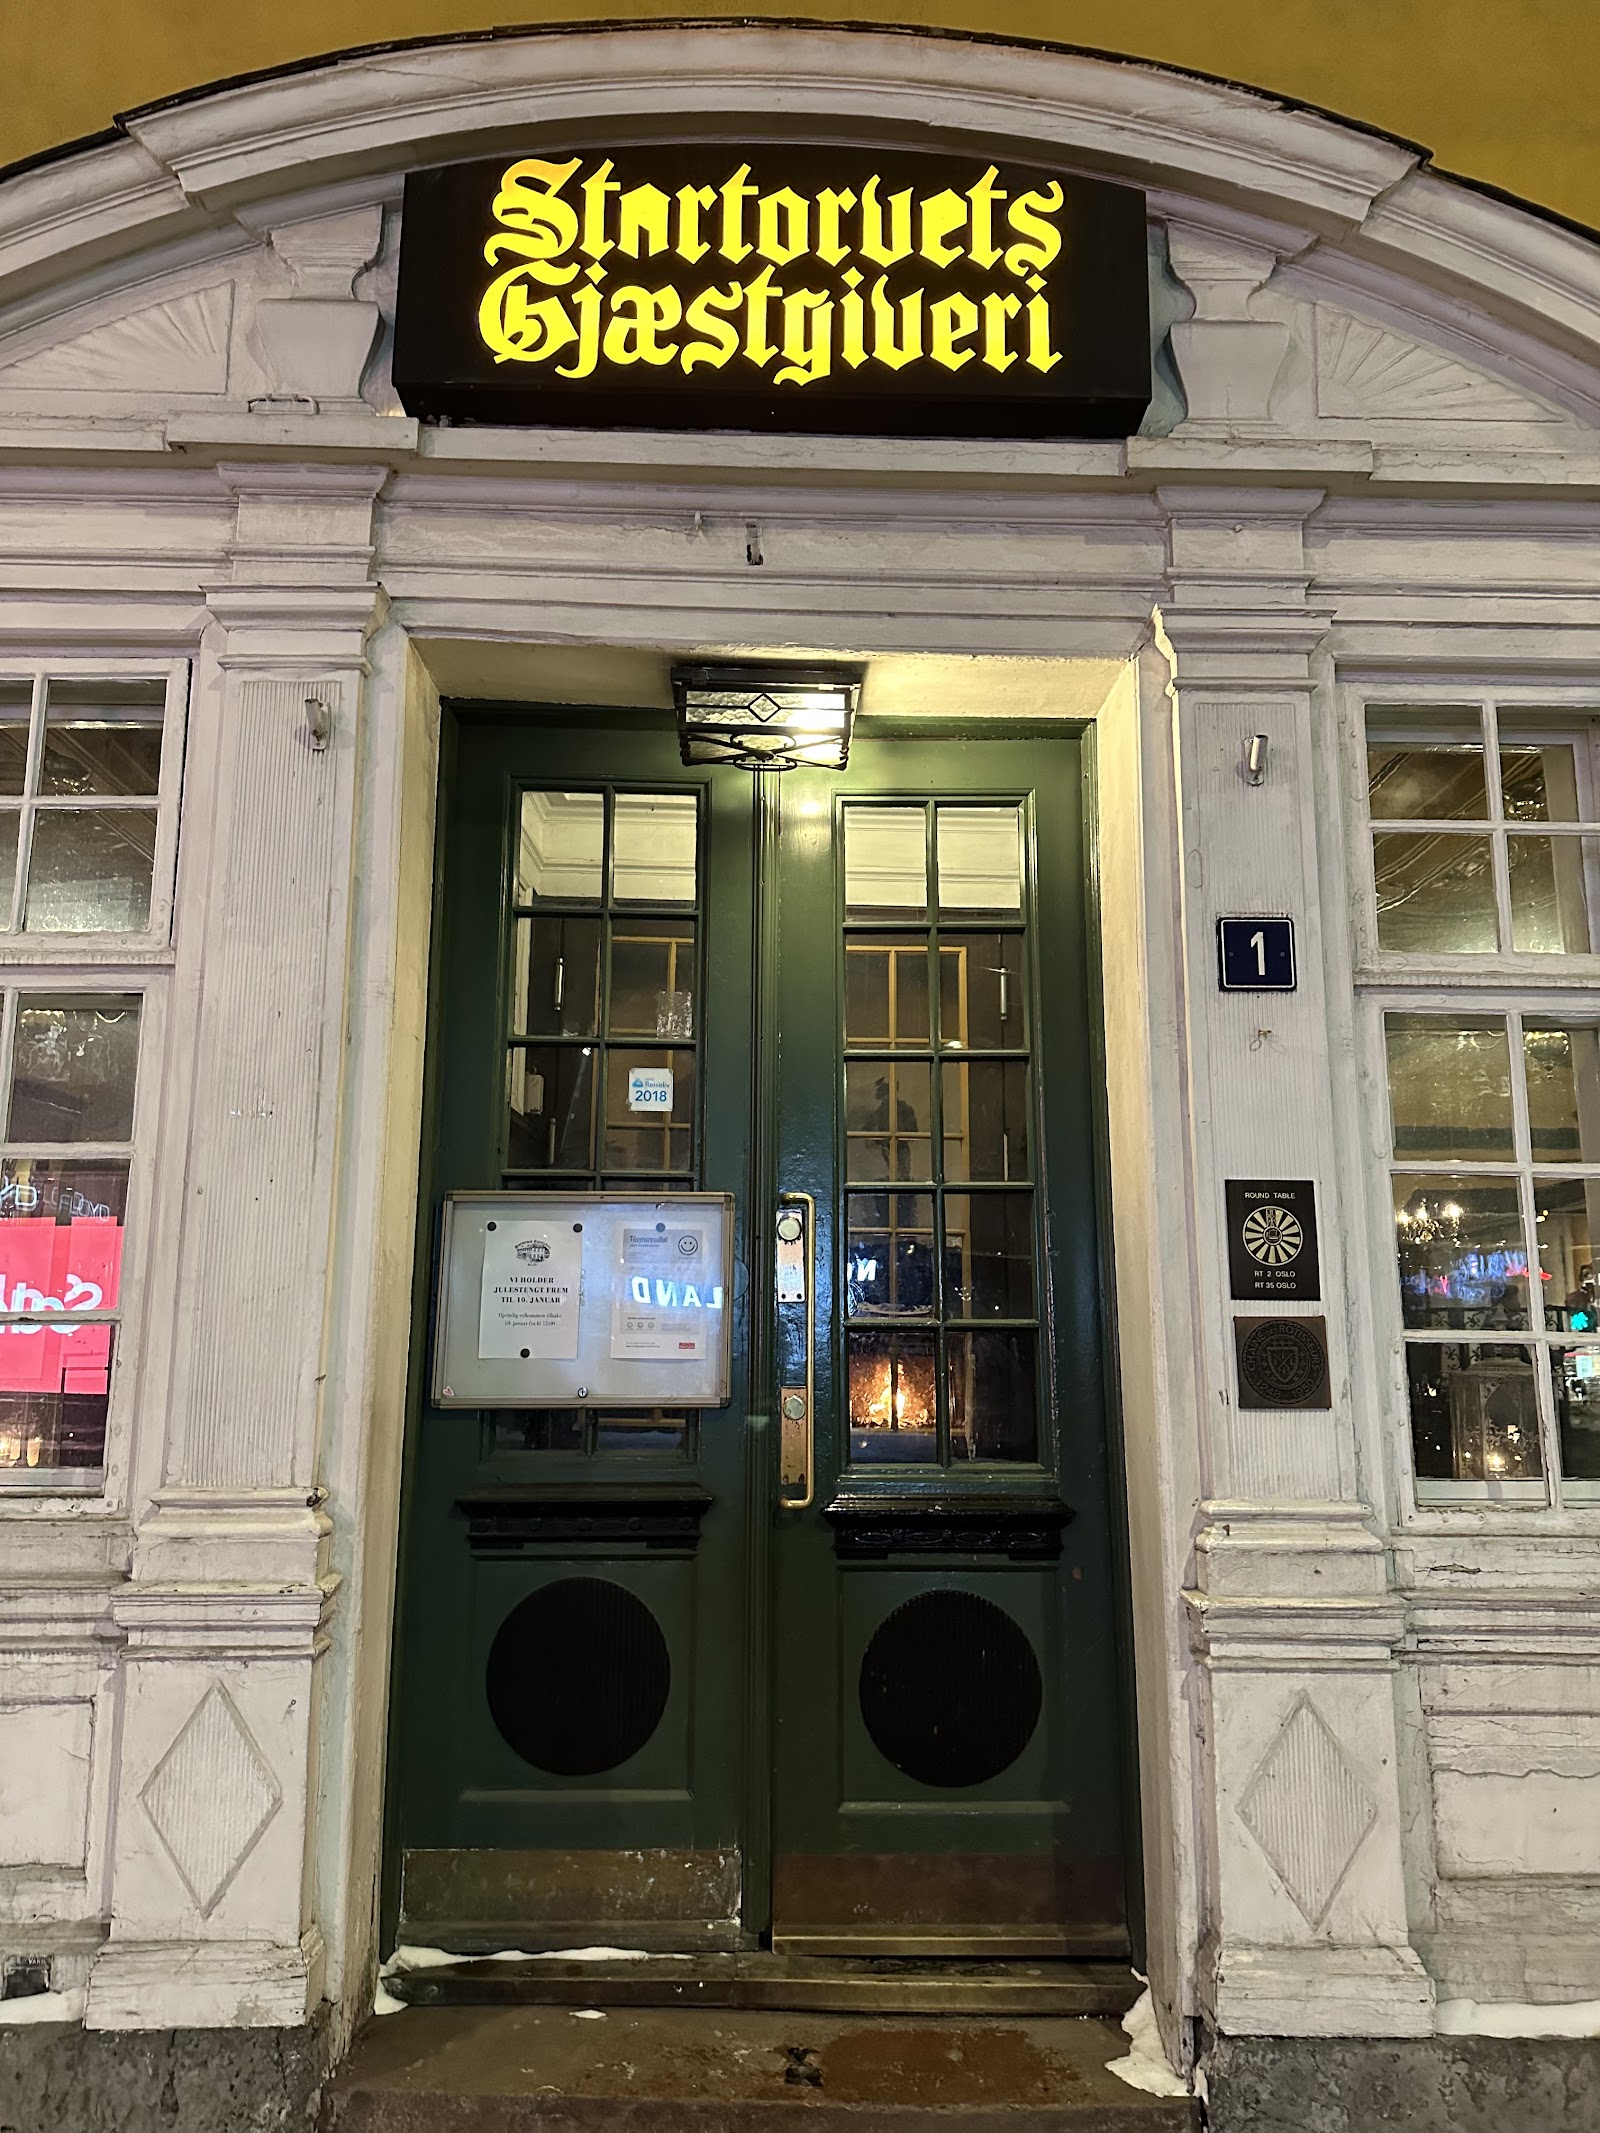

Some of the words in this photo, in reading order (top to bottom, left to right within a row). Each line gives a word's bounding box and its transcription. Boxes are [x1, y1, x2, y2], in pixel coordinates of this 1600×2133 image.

[483, 156, 1065, 287] Stortorvets
[478, 259, 1064, 386] Gjæstgiveri
[1250, 931, 1266, 976] 1
[635, 1090, 667, 1102] 2018
[529, 1296, 561, 1304] JANUAR
[1255, 1380, 1281, 1398] 1248
